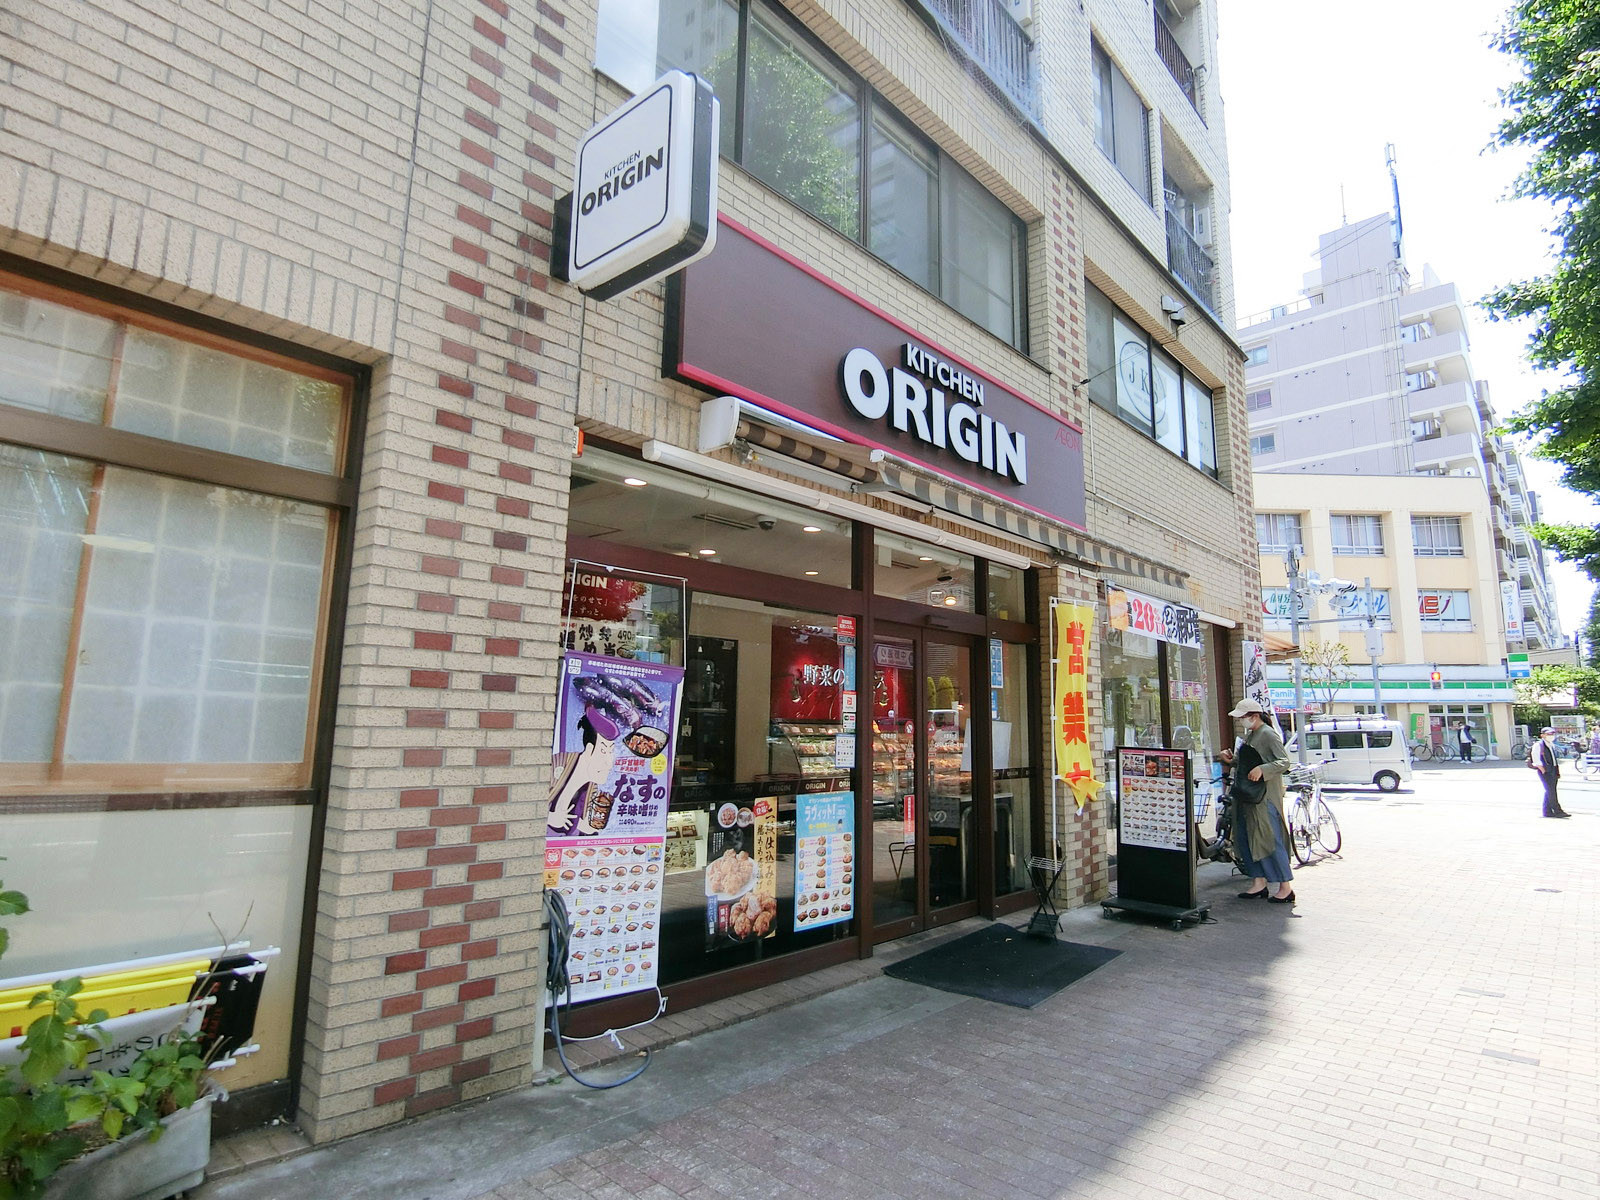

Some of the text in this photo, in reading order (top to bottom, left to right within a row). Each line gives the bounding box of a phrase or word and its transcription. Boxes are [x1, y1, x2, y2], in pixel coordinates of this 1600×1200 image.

[604, 150, 641, 180] KITCHEN
[581, 146, 664, 217] ORIGIN
[905, 342, 985, 406] KITCHEN
[842, 347, 1028, 485] ORIGIN
[565, 571, 608, 589] RIGIN
[1506, 595, 1515, 621] スクール
[1507, 621, 1518, 629] IE
[803, 664, 846, 687] 野菜の
[1270, 688, 1315, 700] Familyart
[613, 773, 666, 803] なすの
[805, 782, 826, 790] ORIGIN
[616, 803, 648, 817] 辛味噌
